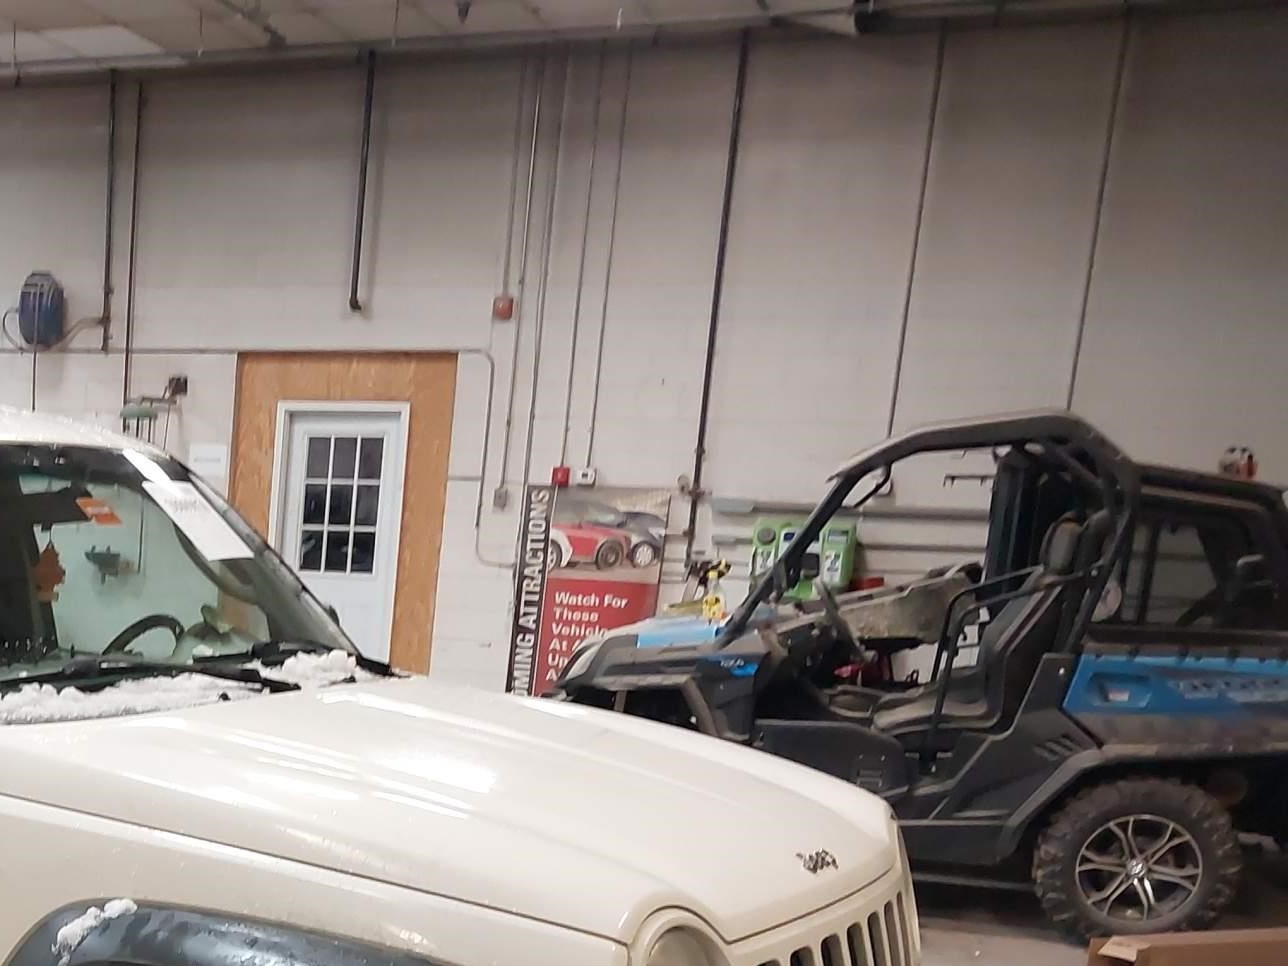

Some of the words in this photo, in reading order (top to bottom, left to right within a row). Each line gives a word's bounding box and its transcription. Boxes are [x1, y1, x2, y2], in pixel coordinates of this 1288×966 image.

[519, 489, 550, 628] ATTRACTIONS
[554, 591, 600, 607] Watch
[603, 593, 629, 609] For
[553, 606, 599, 622] These
[548, 638, 569, 651] At
